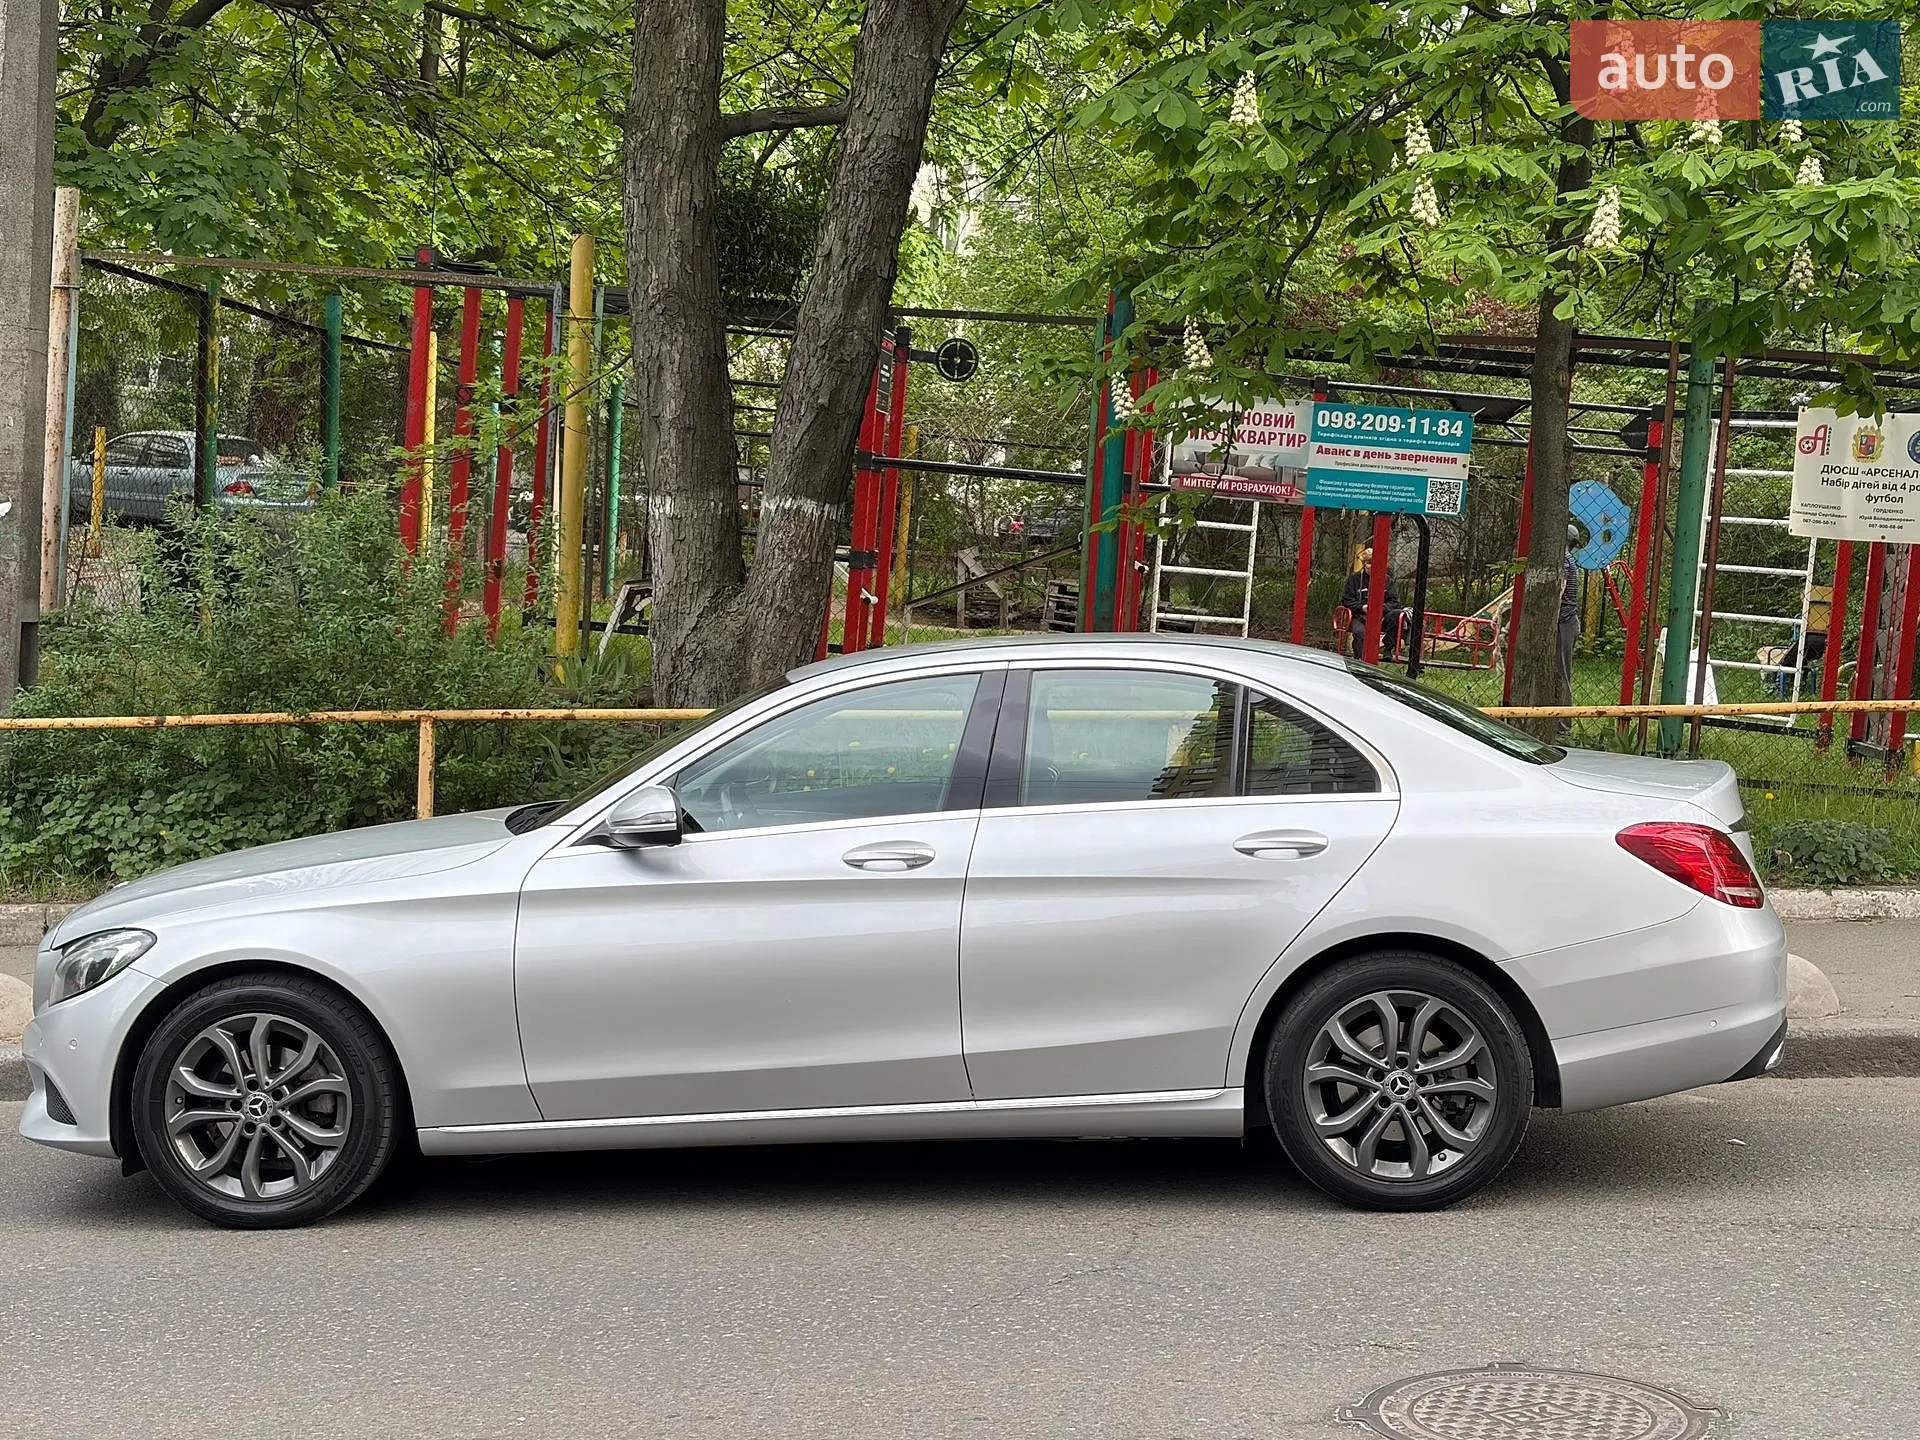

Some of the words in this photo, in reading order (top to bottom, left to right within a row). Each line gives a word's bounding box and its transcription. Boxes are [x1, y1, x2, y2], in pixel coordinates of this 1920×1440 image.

[1236, 429, 1308, 448] КВАРТИР
[1316, 445, 1351, 457] Аванс
[1354, 449, 1360, 457] в
[1362, 450, 1391, 460] день
[1394, 452, 1458, 465] звернення
[1820, 464, 1859, 476] ДЮСШ
[1231, 481, 1291, 495] РОЗРАХУНОК!
[1821, 477, 1850, 490] Набір
[1851, 479, 1880, 490] дітей
[1881, 481, 1898, 491] від
[1899, 482, 1907, 491] 4
[1865, 493, 1904, 504] футбол
